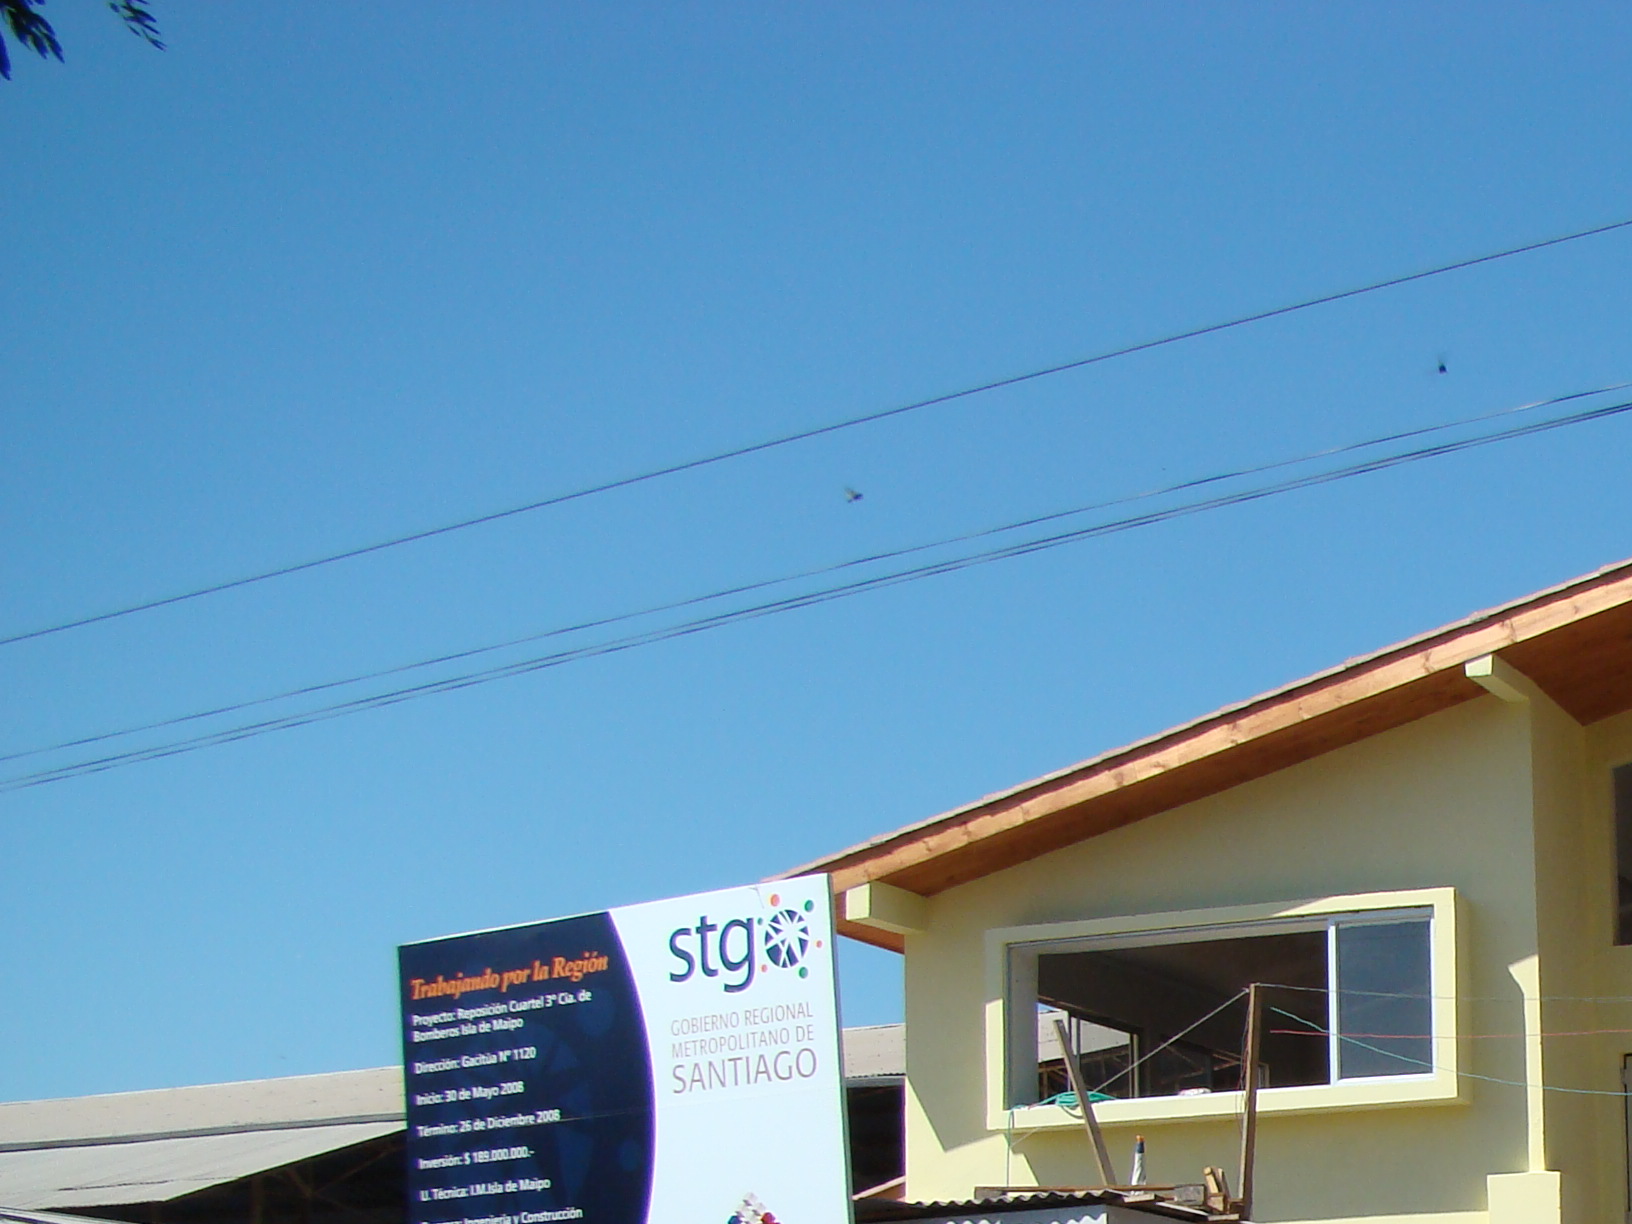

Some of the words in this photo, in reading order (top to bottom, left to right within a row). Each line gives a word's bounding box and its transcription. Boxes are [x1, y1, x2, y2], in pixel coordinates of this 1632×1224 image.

[410, 968, 499, 1000] Trabajando
[501, 967, 530, 992] por
[532, 960, 549, 981] la
[552, 951, 608, 982] Región
[413, 1011, 455, 1027] Proyecto:
[457, 1000, 508, 1022] Reposición
[509, 996, 543, 1012] Cuartel
[579, 990, 592, 1002] de
[671, 1012, 740, 1036] GOBIERNO
[744, 1001, 813, 1026] REGIONAL
[413, 1025, 460, 1043] Bomberos
[461, 1022, 476, 1035] Isla
[478, 1019, 491, 1033] de
[492, 1017, 524, 1034] Maipo
[672, 1028, 789, 1059] METROPOLITANO
[796, 1025, 814, 1042] DE
[415, 1058, 460, 1075] Dirección:
[513, 1046, 536, 1060] 1120
[672, 1048, 817, 1094] SANTIAGO
[416, 1091, 443, 1106] Inicio:
[445, 1090, 457, 1102] 30
[459, 1087, 471, 1100] de
[472, 1085, 499, 1102] Mayo
[418, 1122, 458, 1138] Término:
[459, 1119, 472, 1132] 26
[473, 1117, 485, 1130] de
[487, 1113, 535, 1128] Diciembre
[419, 1155, 463, 1170] Inversión:
[464, 1152, 471, 1165] $
[420, 1190, 432, 1201] U.
[433, 1185, 469, 1200] Técnica:
[505, 1180, 517, 1193] de
[519, 1177, 551, 1193] Maipo
[520, 1207, 583, 1224] Construcción
